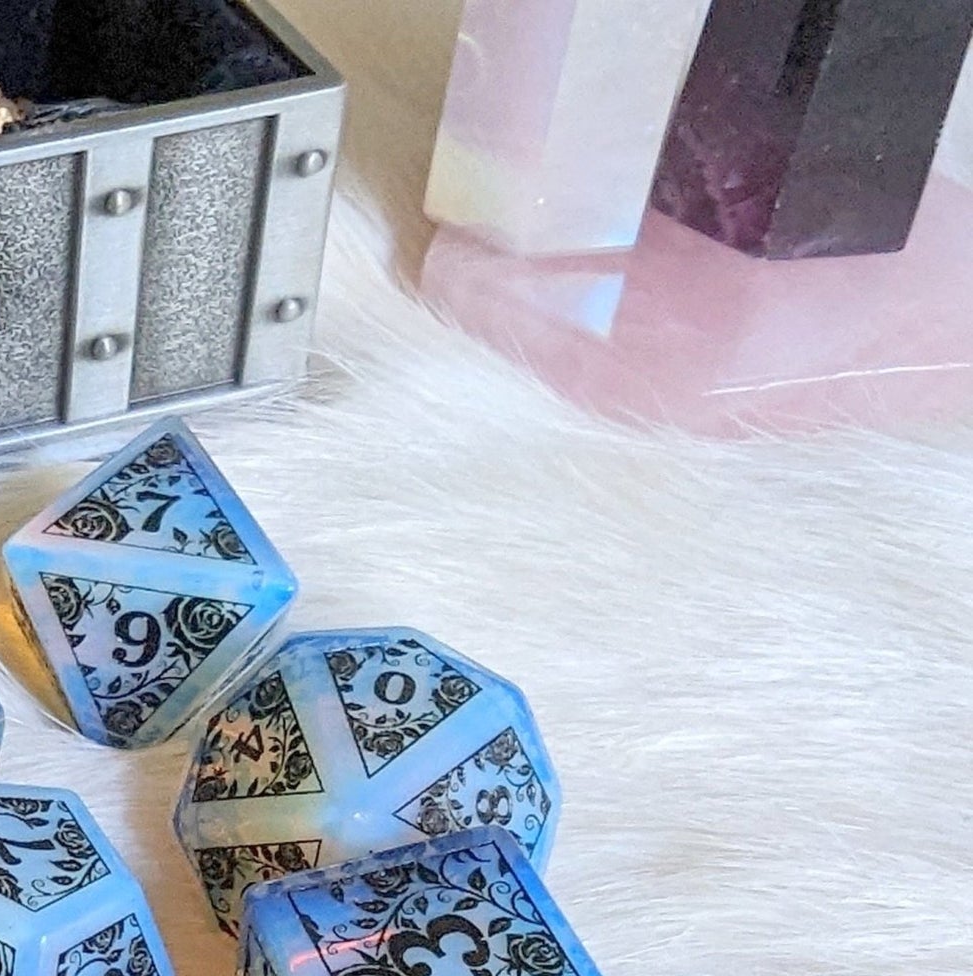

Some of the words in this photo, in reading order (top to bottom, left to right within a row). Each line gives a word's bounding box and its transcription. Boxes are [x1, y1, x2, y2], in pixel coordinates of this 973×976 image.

[136, 491, 181, 532] 7
[374, 671, 416, 704] 0
[475, 785, 513, 826] 8
